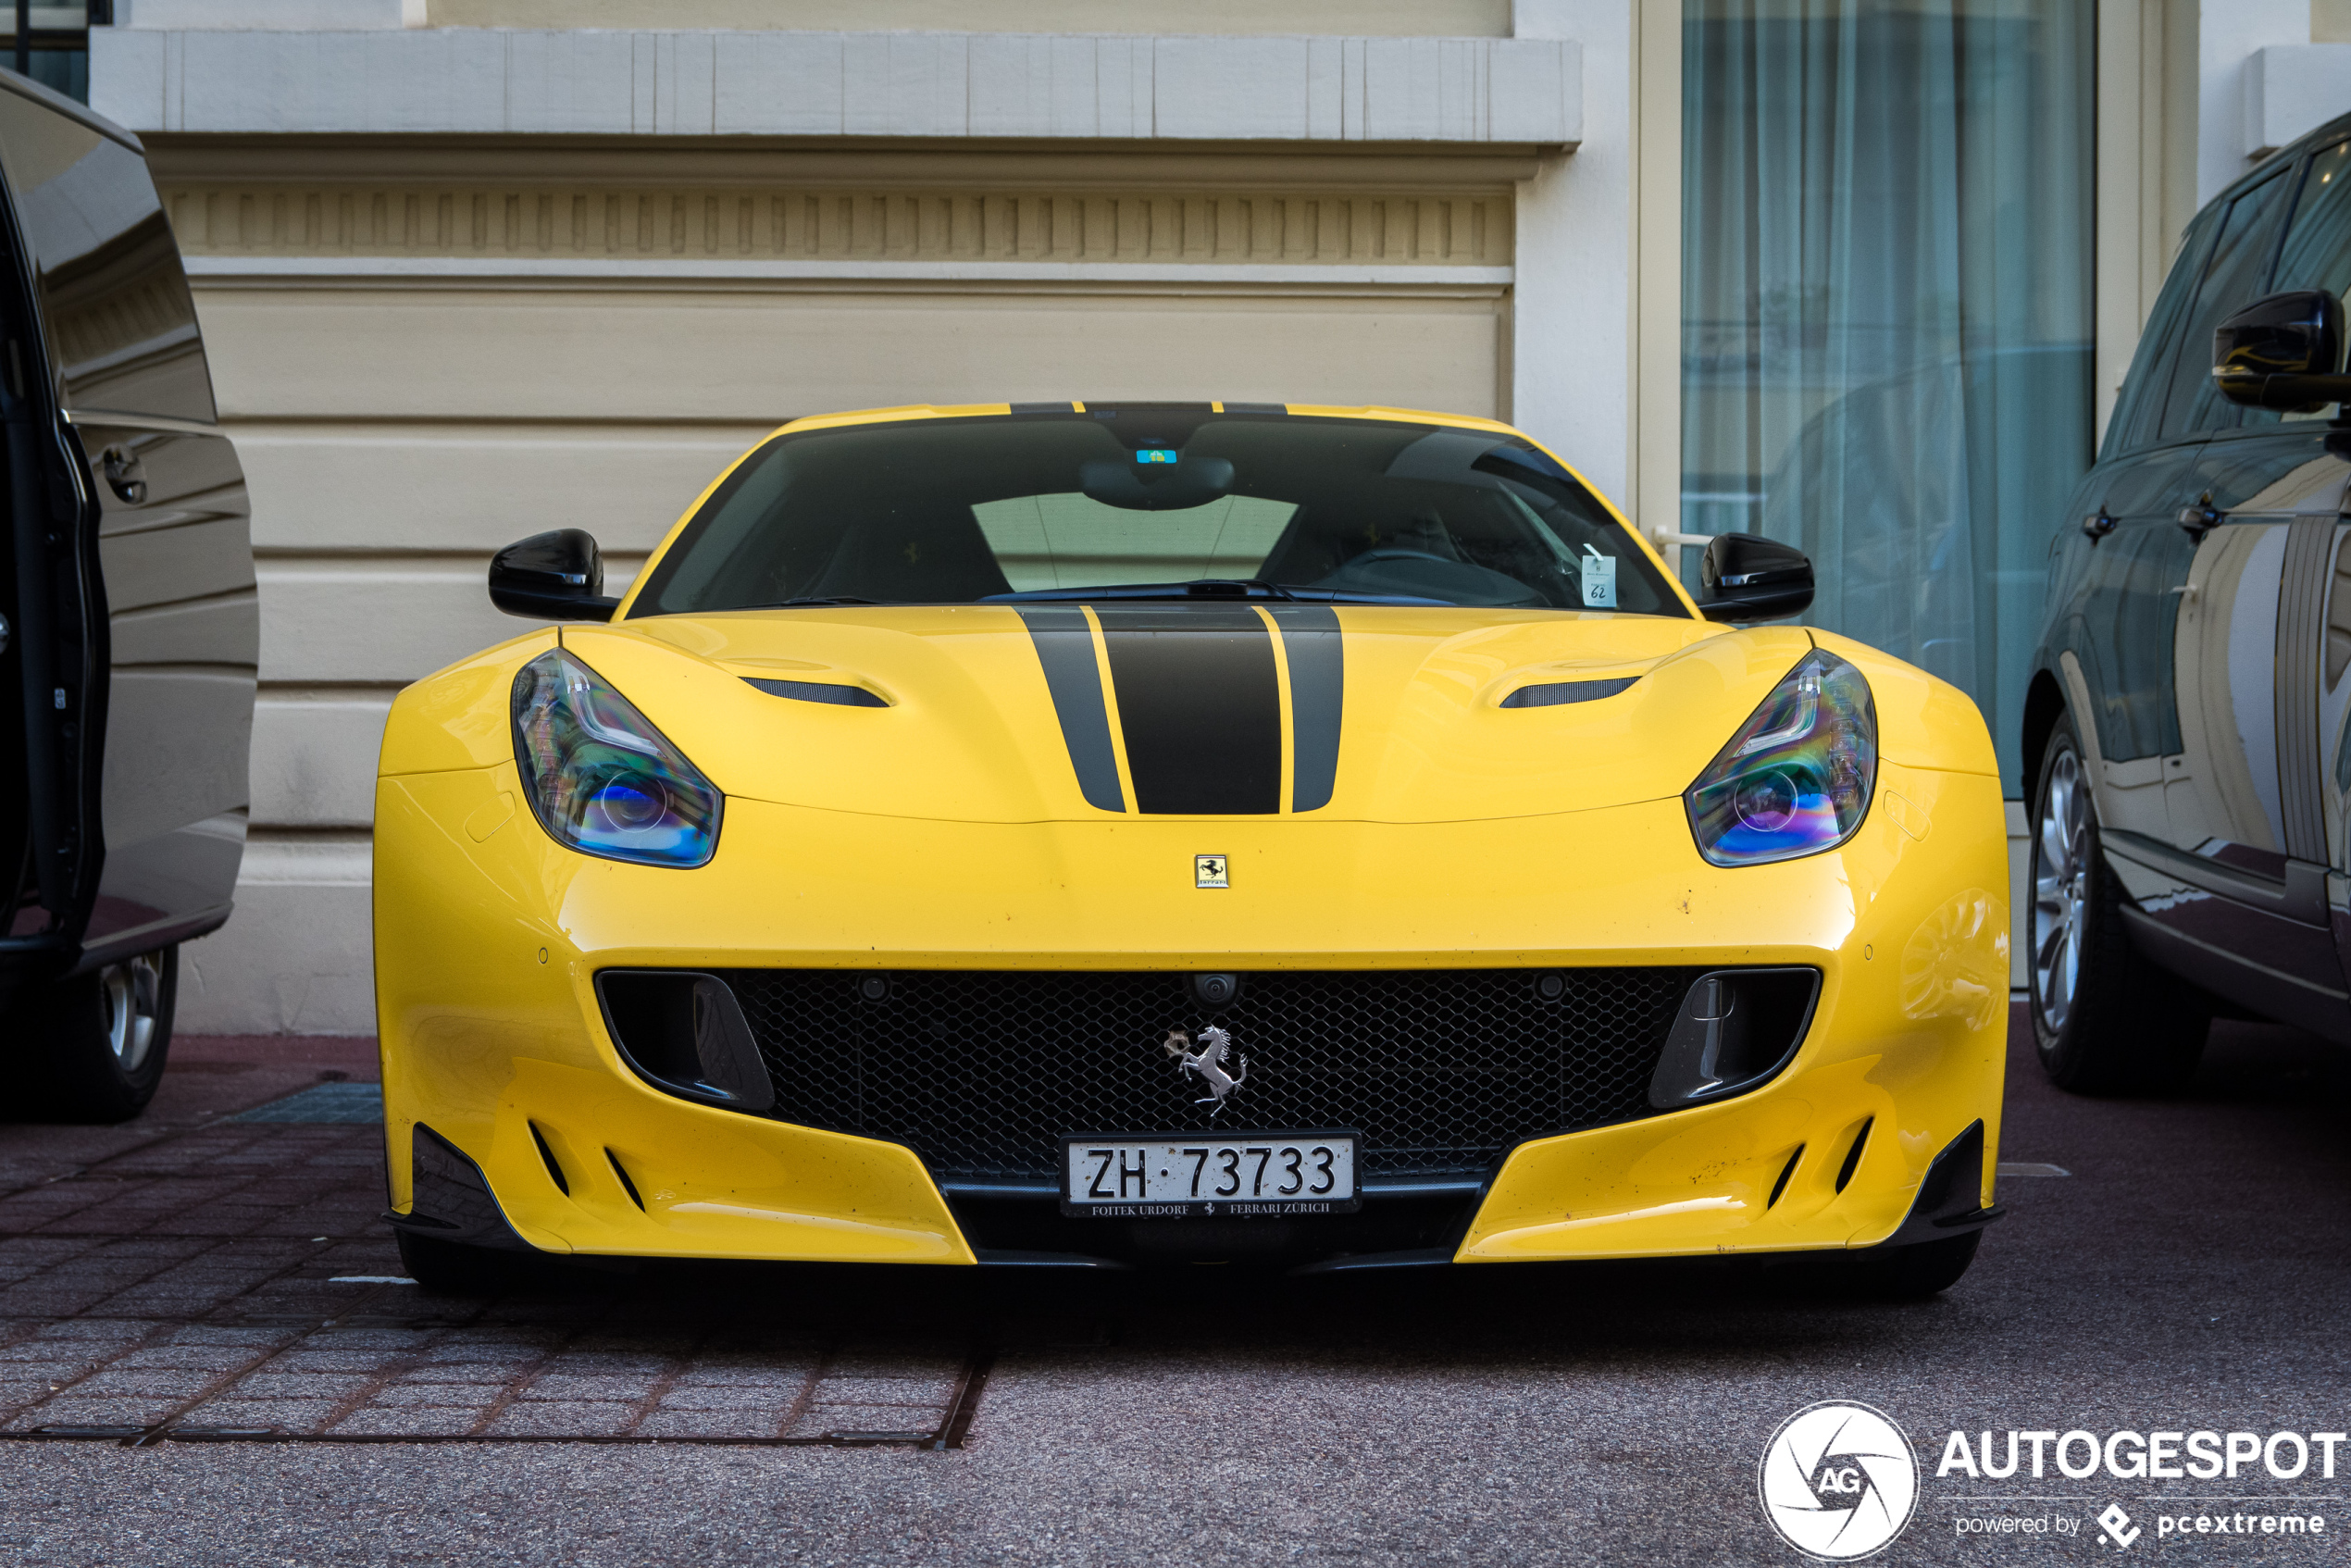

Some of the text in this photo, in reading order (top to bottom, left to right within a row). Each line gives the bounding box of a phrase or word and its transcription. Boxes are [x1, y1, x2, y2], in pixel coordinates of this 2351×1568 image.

[1591, 586, 1606, 599] 62
[1088, 1149, 1147, 1198] ZH
[1183, 1146, 1336, 1197] 73733
[1092, 1204, 1189, 1216] FOITEK URDORF
[1230, 1202, 1330, 1213] FERRARI ZÜRICH
